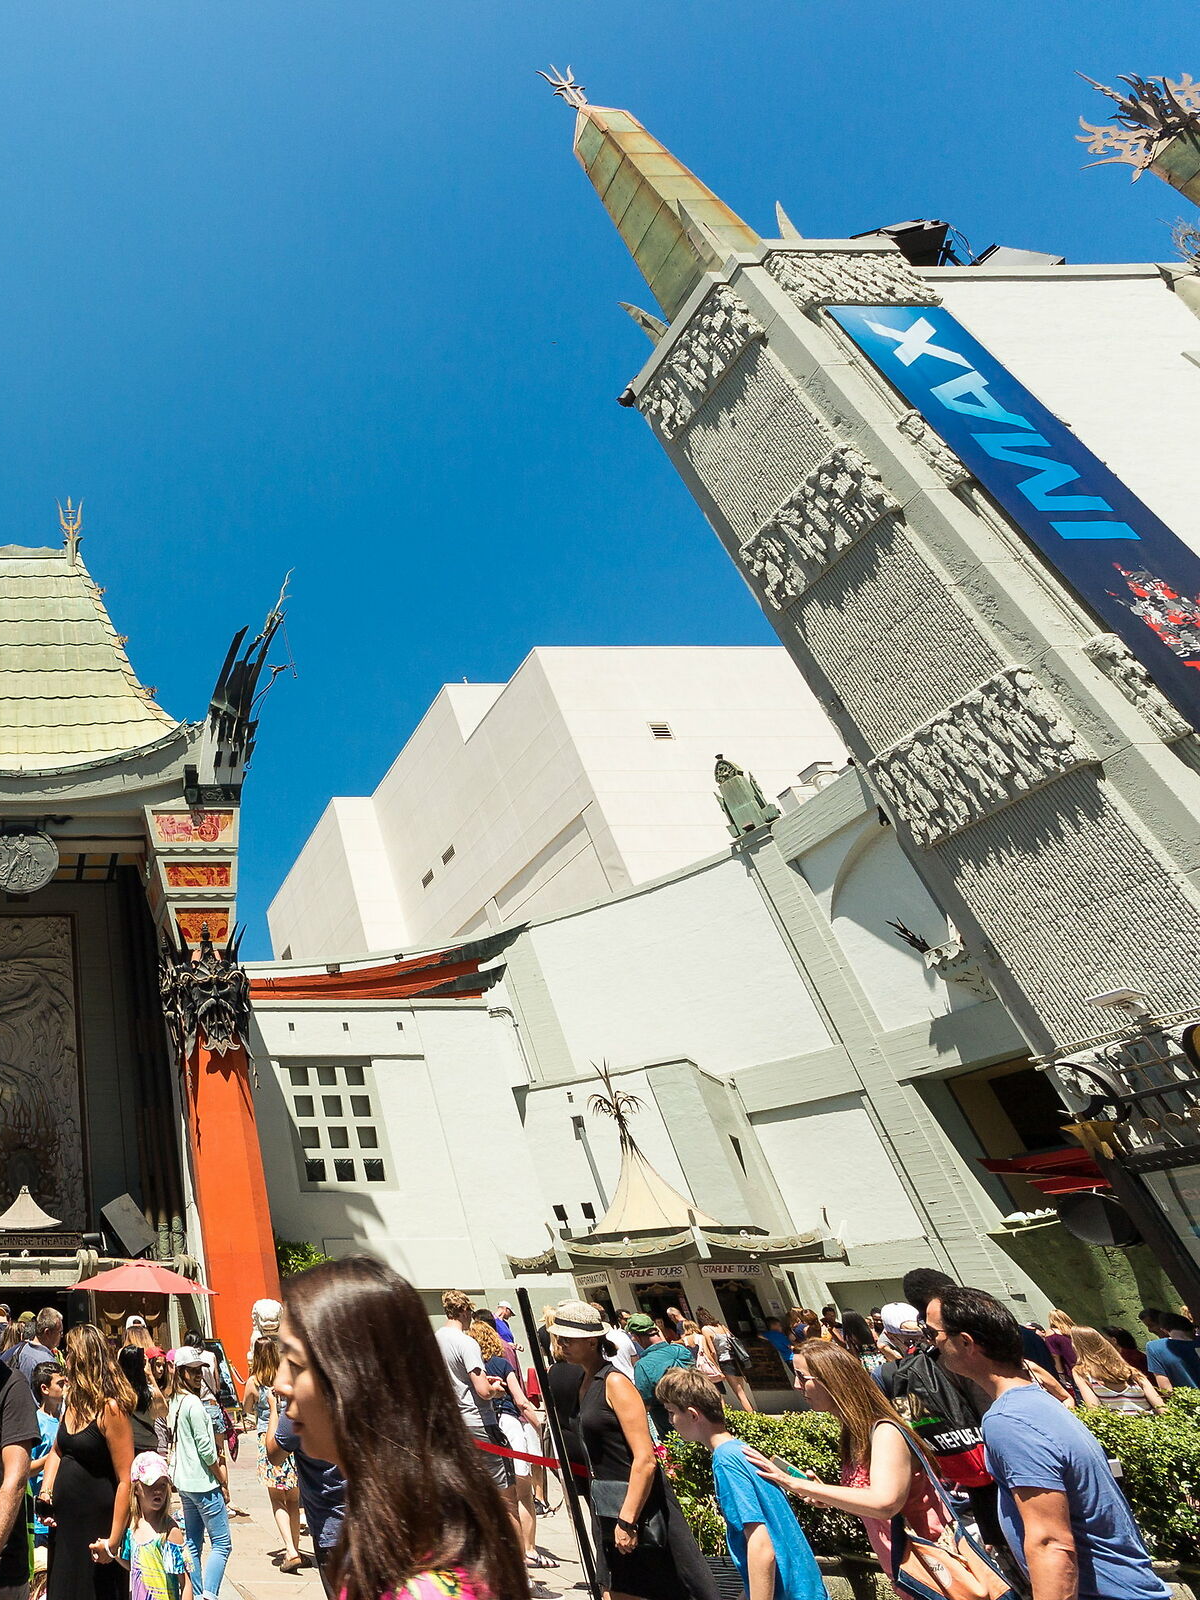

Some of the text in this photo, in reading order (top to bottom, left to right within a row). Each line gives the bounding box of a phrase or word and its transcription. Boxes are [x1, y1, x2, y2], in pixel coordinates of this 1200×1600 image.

[864, 316, 1141, 541] IMAX
[0, 1237, 34, 1246] CHINESE
[619, 1268, 654, 1279] STARLINE
[656, 1266, 683, 1276] TOURS
[703, 1265, 735, 1274] STARLINE
[736, 1264, 760, 1273] TOURS
[577, 1272, 608, 1286] INFORMATION
